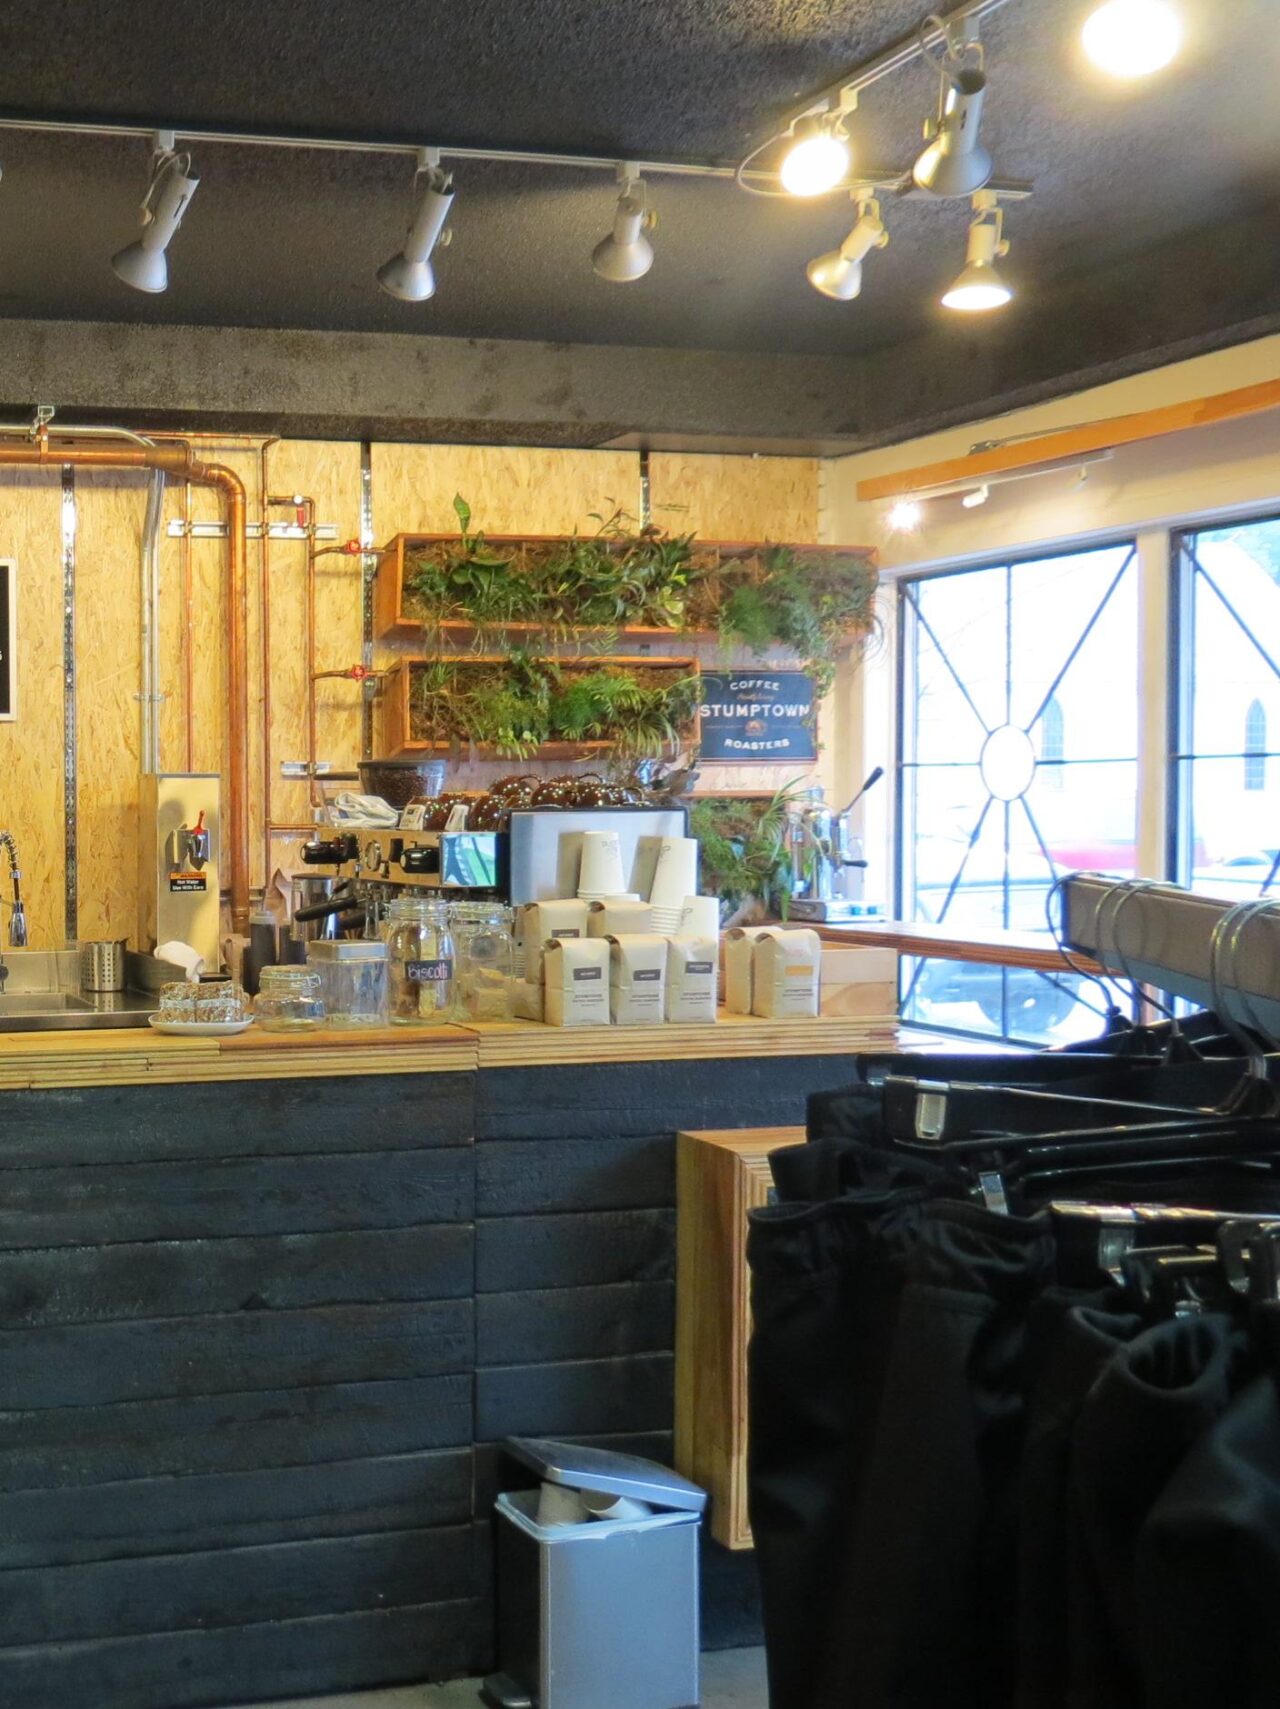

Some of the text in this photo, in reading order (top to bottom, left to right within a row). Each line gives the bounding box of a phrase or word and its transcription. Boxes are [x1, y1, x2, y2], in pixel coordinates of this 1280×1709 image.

[729, 680, 780, 690] COFFEE
[700, 704, 810, 717] STUMPTOWN
[724, 738, 790, 750] ROASTERS
